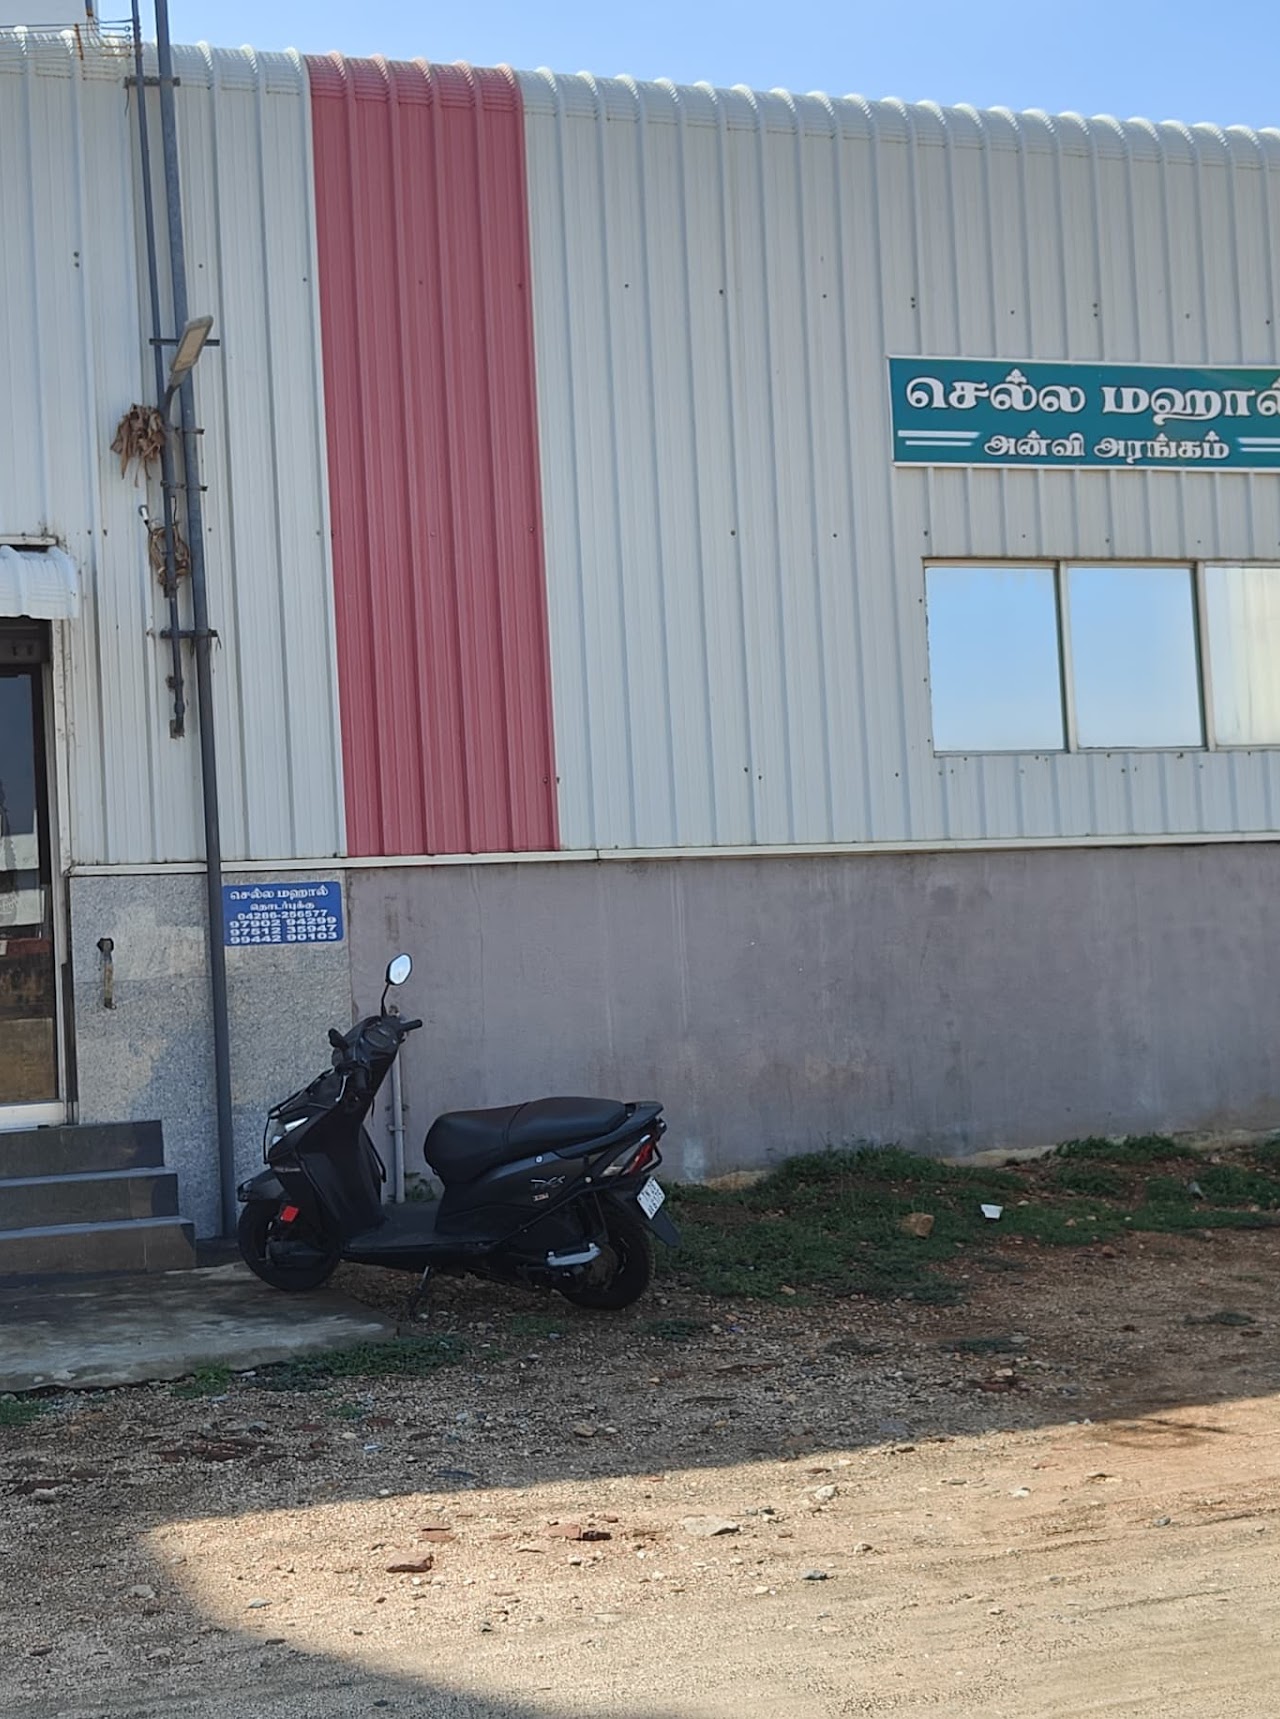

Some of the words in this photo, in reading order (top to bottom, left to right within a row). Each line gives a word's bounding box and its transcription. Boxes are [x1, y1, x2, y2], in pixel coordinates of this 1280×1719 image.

[906, 368, 1086, 414] செல்ல
[984, 430, 1085, 459] அன்வி
[1094, 430, 1230, 464] அரங்கம்
[230, 887, 274, 900] செல்ல
[277, 884, 328, 900] மஹால்
